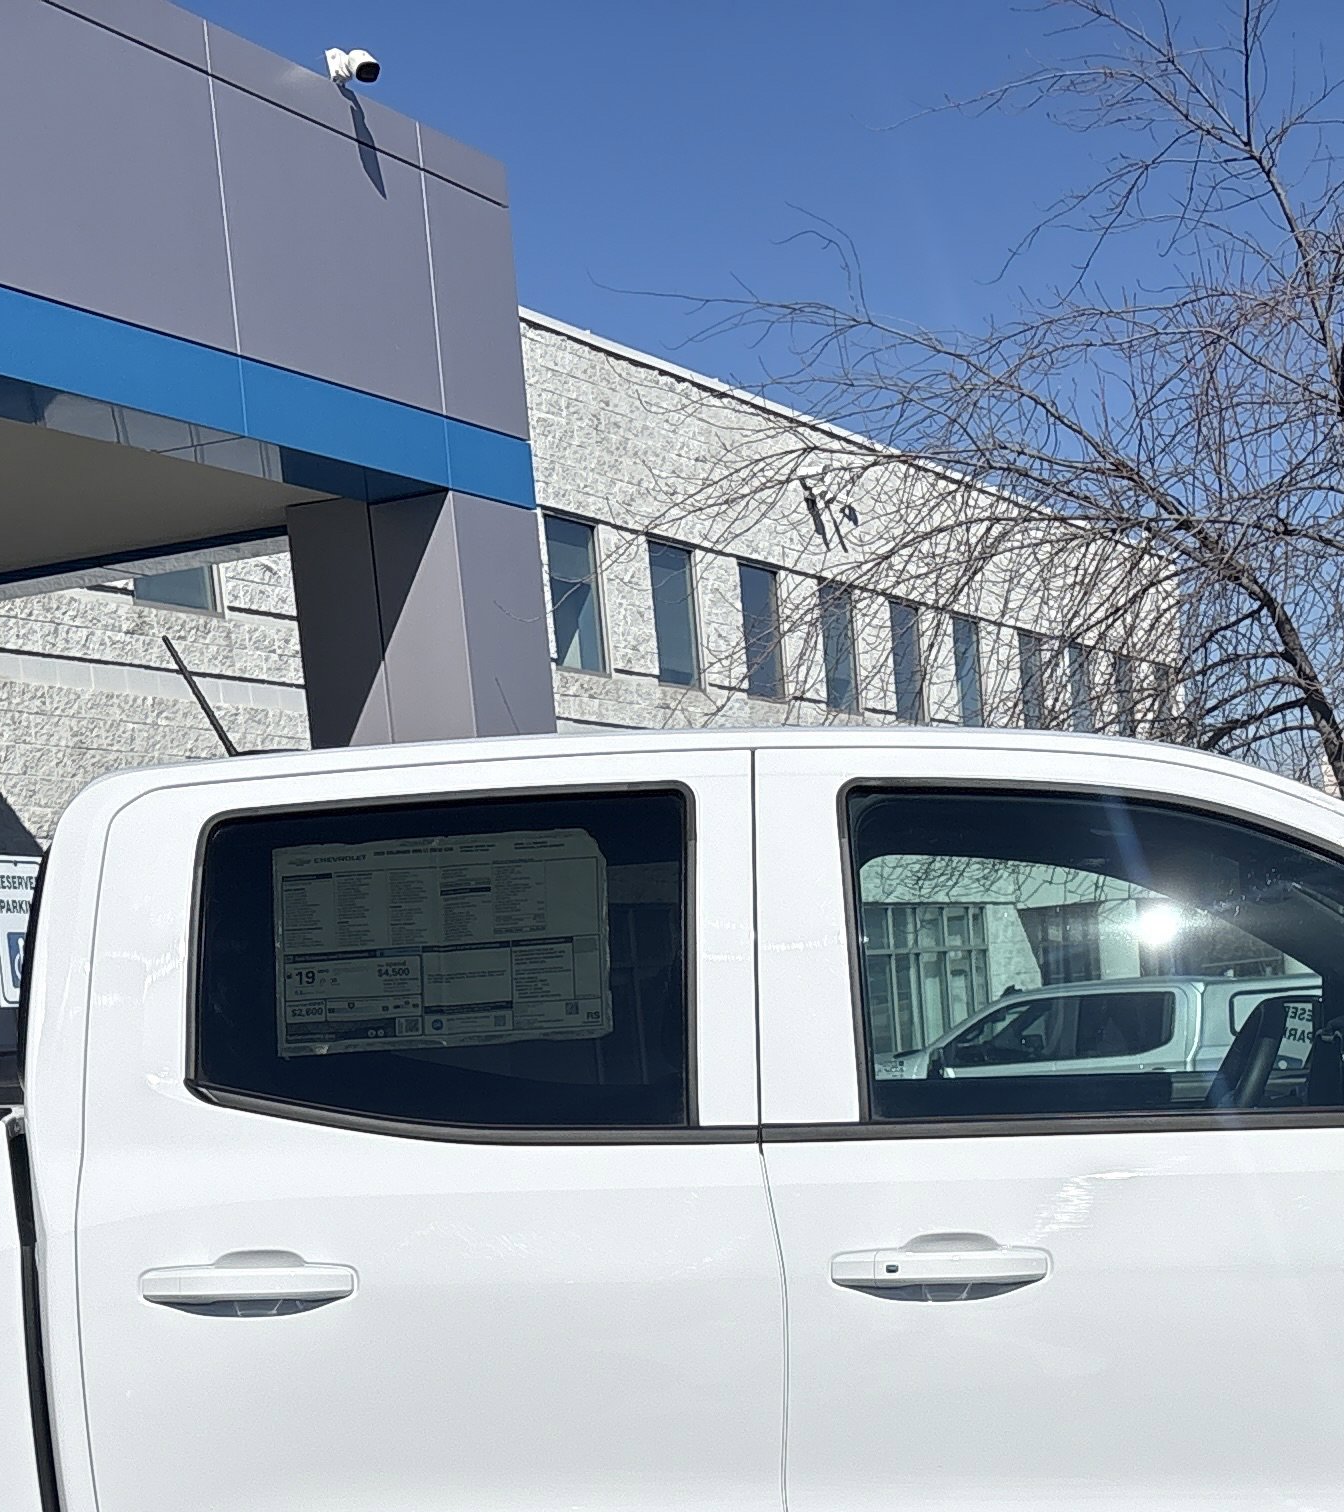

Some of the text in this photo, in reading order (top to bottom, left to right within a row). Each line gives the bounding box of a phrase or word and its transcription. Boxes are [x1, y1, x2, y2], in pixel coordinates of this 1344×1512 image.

[314, 854, 367, 864] CHEVROLET
[0, 899, 31, 914] PARKI
[295, 970, 316, 985] 19
[586, 1011, 600, 1020] RS
